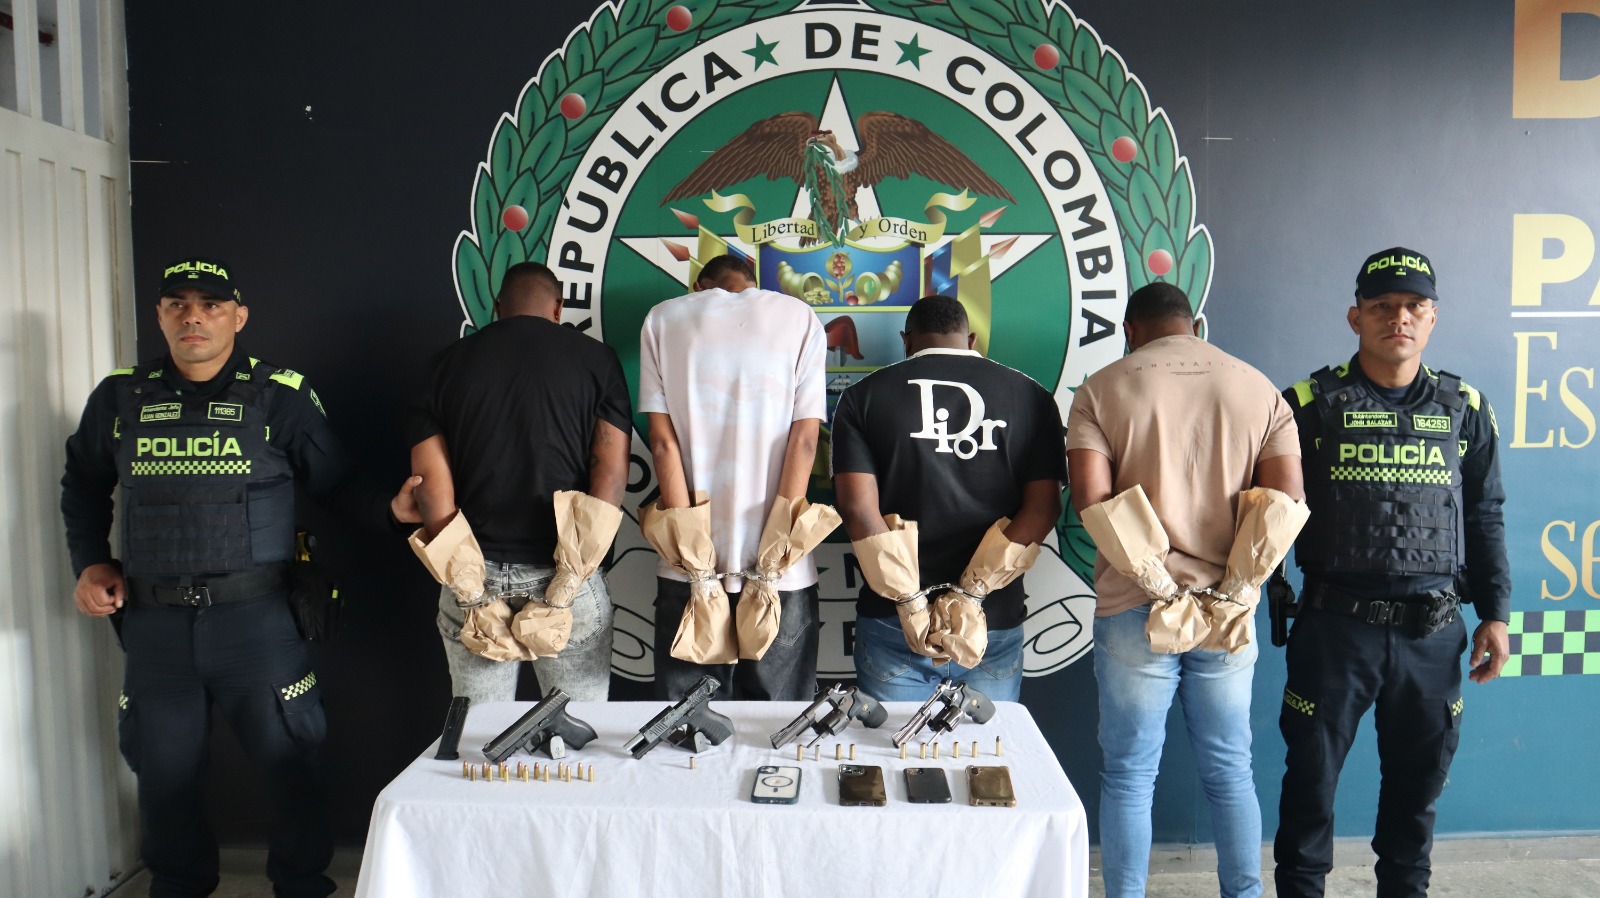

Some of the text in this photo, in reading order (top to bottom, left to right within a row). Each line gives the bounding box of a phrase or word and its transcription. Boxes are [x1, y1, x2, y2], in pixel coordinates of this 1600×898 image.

[805, 22, 881, 62] DE
[946, 56, 1117, 348] COLOMBIA
[752, 218, 928, 243] Libertad y Orden
[164, 261, 229, 280] POLICÍA
[1367, 256, 1431, 275] POLICÍA
[1511, 213, 1600, 306] P
[907, 378, 1007, 460] Dior
[1417, 418, 1448, 430] 164253
[137, 431, 242, 457] POLICÍA
[1339, 439, 1446, 467] POLICÍA
